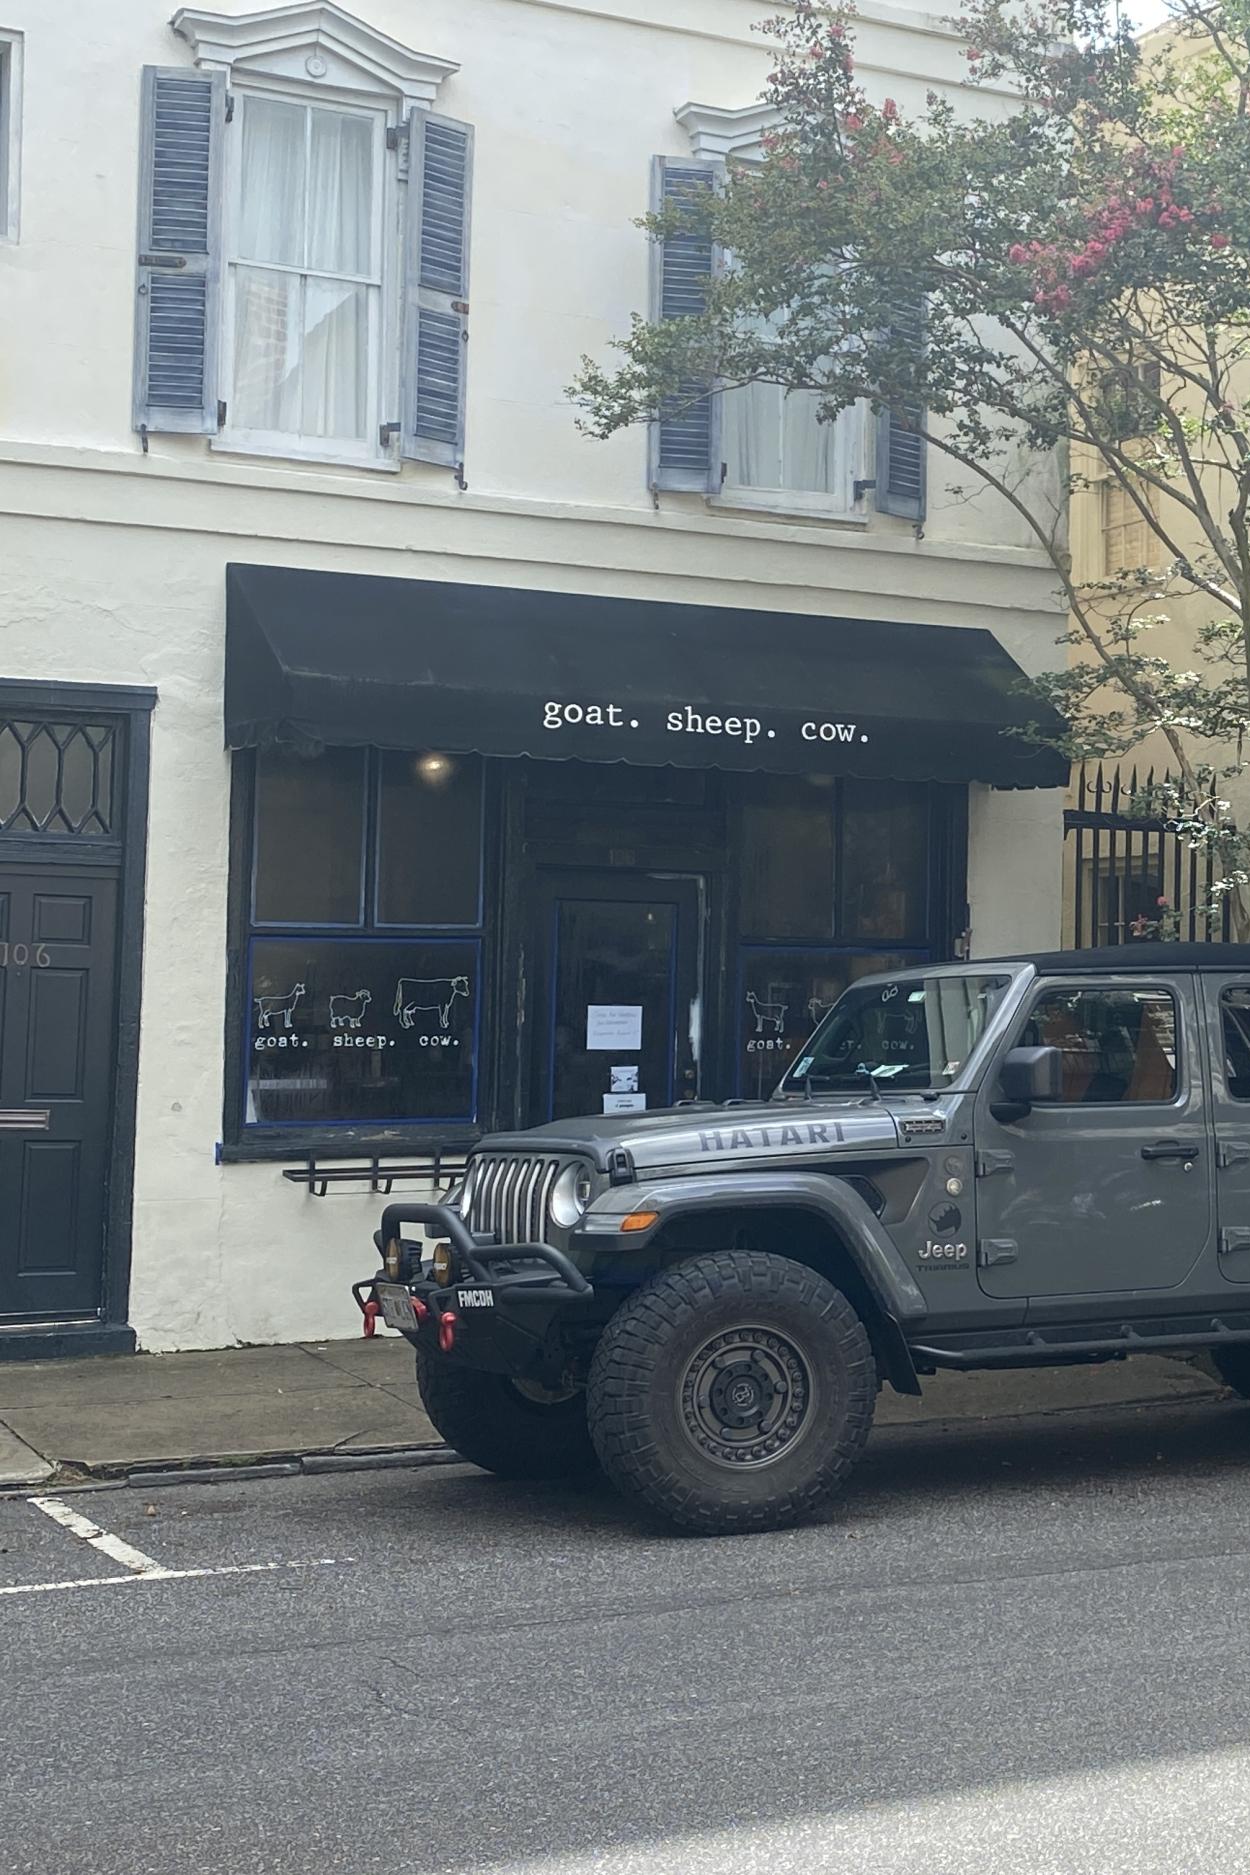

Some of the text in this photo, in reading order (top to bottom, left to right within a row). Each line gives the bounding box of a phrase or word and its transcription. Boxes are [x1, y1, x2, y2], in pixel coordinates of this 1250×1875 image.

[543, 701, 869, 744] goat. sheep. cow.
[2, 942, 51, 968] 106
[254, 1033, 460, 1051] goat. sheep. cow.
[746, 1036, 791, 1052] goat.
[698, 1121, 846, 1151] HATARI
[918, 1241, 967, 1260] Jeep
